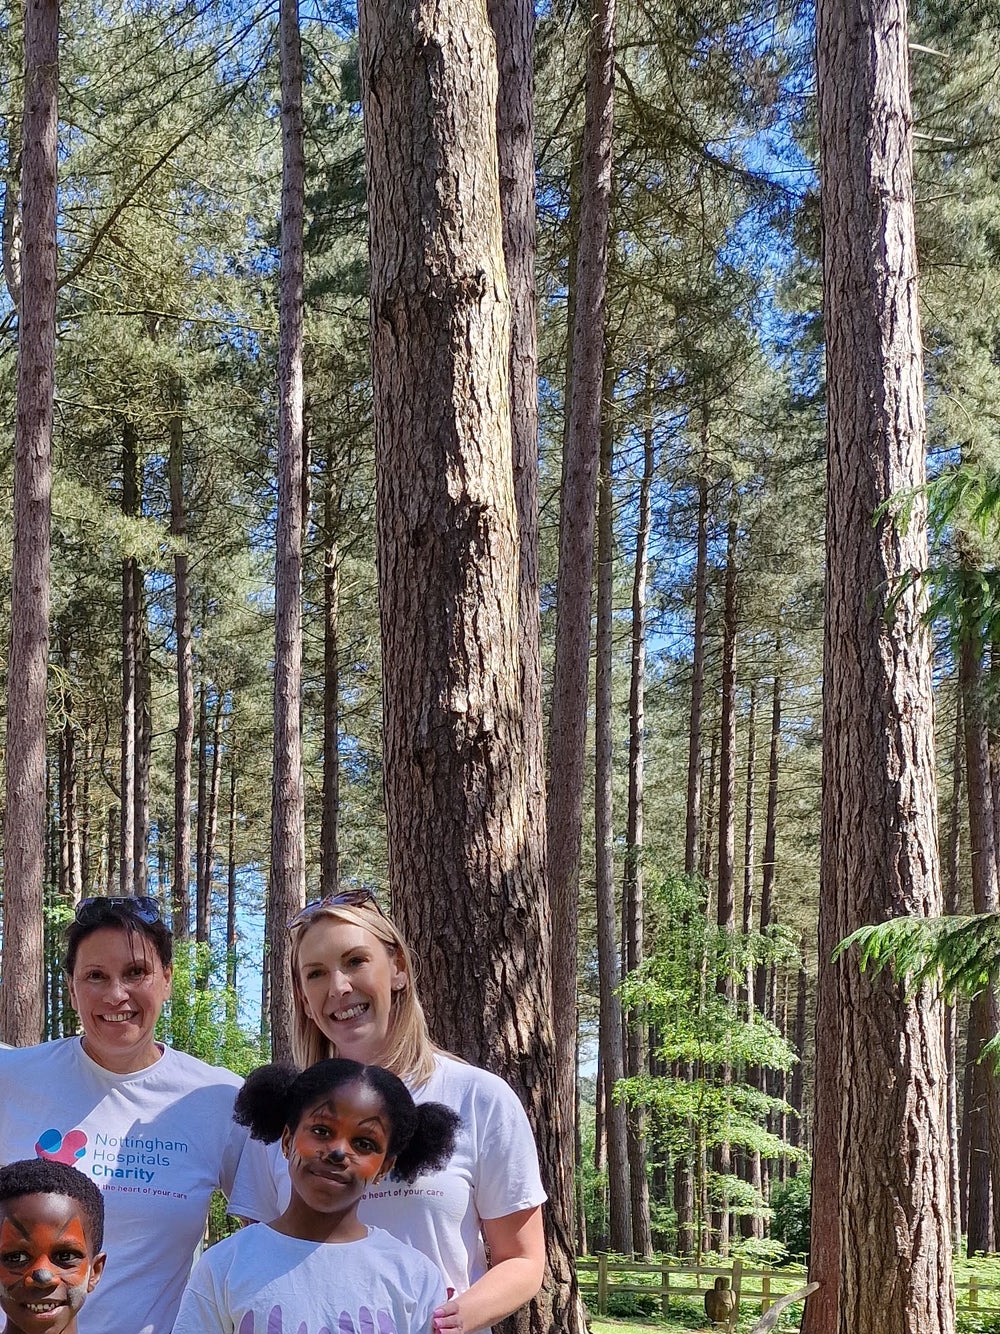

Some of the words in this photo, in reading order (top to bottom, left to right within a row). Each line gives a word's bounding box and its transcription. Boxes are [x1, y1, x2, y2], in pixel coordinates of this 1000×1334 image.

[95, 1133, 188, 1153] Nottingham
[93, 1149, 170, 1167] Hospitals
[92, 1164, 155, 1183] Charity
[117, 1185, 140, 1193] heart
[152, 1189, 171, 1197] your
[369, 1190, 391, 1199] heart
[393, 1188, 402, 1197] of
[404, 1189, 424, 1197] your
[426, 1189, 445, 1197] care
